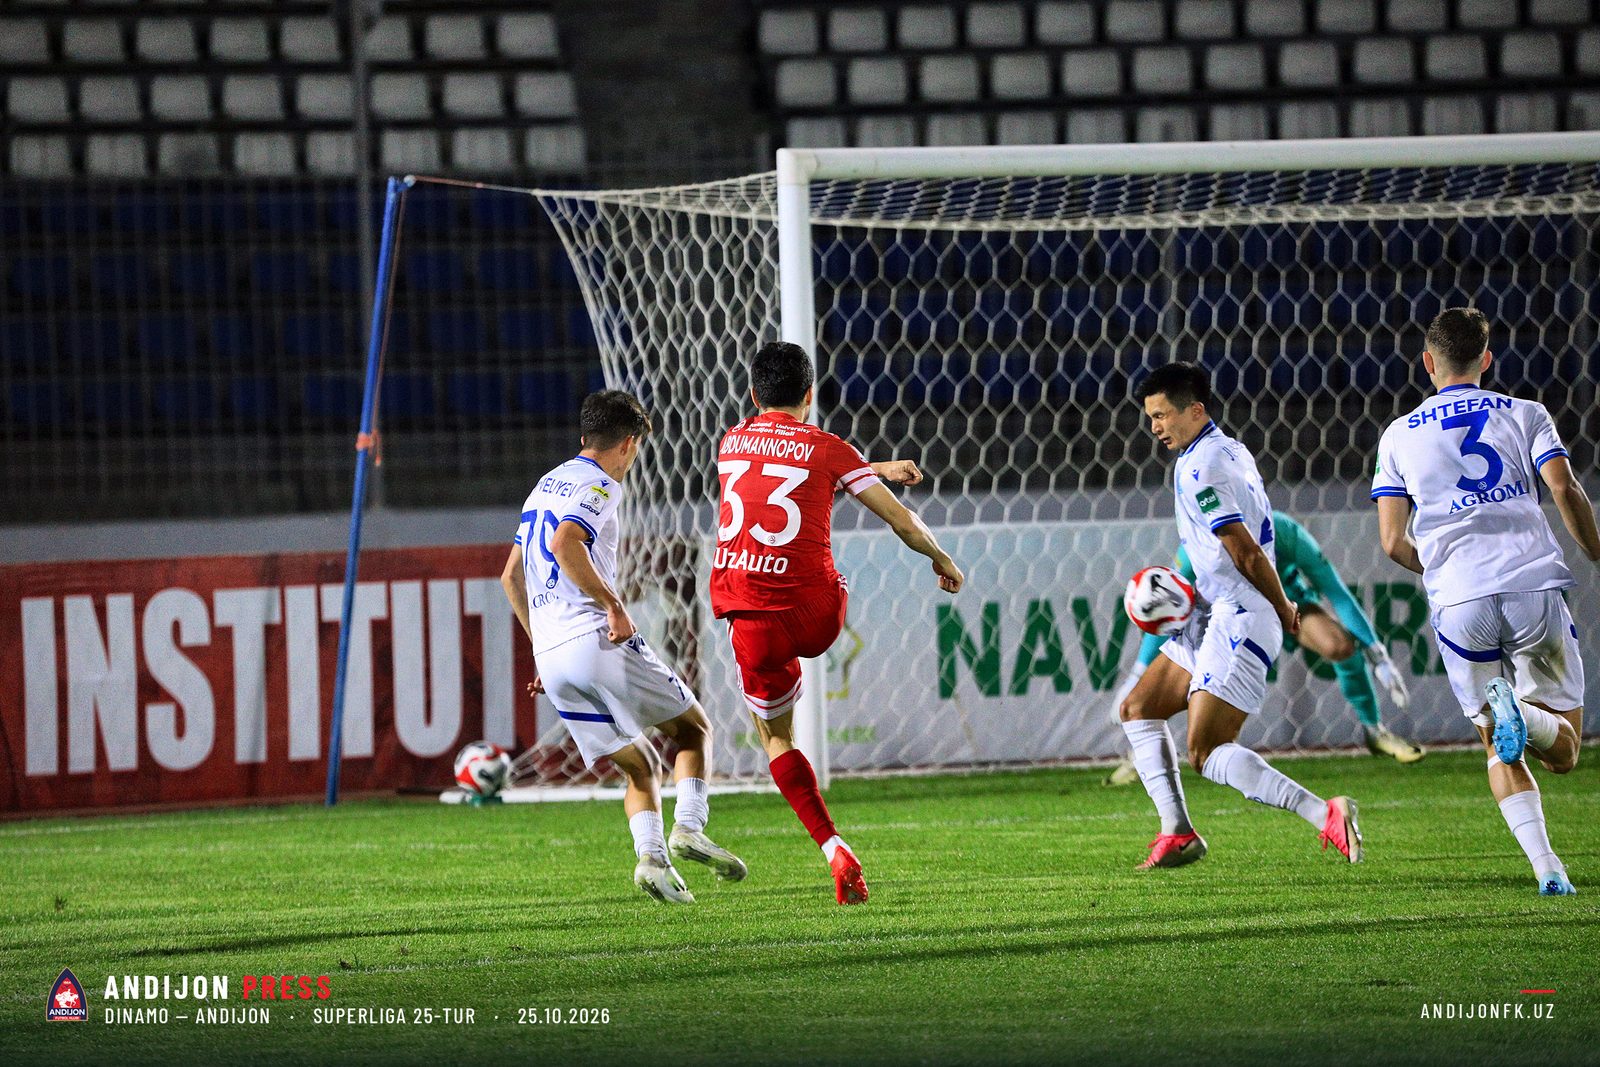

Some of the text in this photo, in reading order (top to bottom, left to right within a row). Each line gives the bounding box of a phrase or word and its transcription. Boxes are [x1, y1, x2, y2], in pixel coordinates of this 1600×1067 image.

[775, 423, 812, 434] University
[1408, 397, 1512, 429] SHTEFAN
[1440, 409, 1503, 492] 3
[717, 459, 810, 547] 33
[714, 548, 789, 574] UzAuto
[20, 577, 552, 777] INSTITUT
